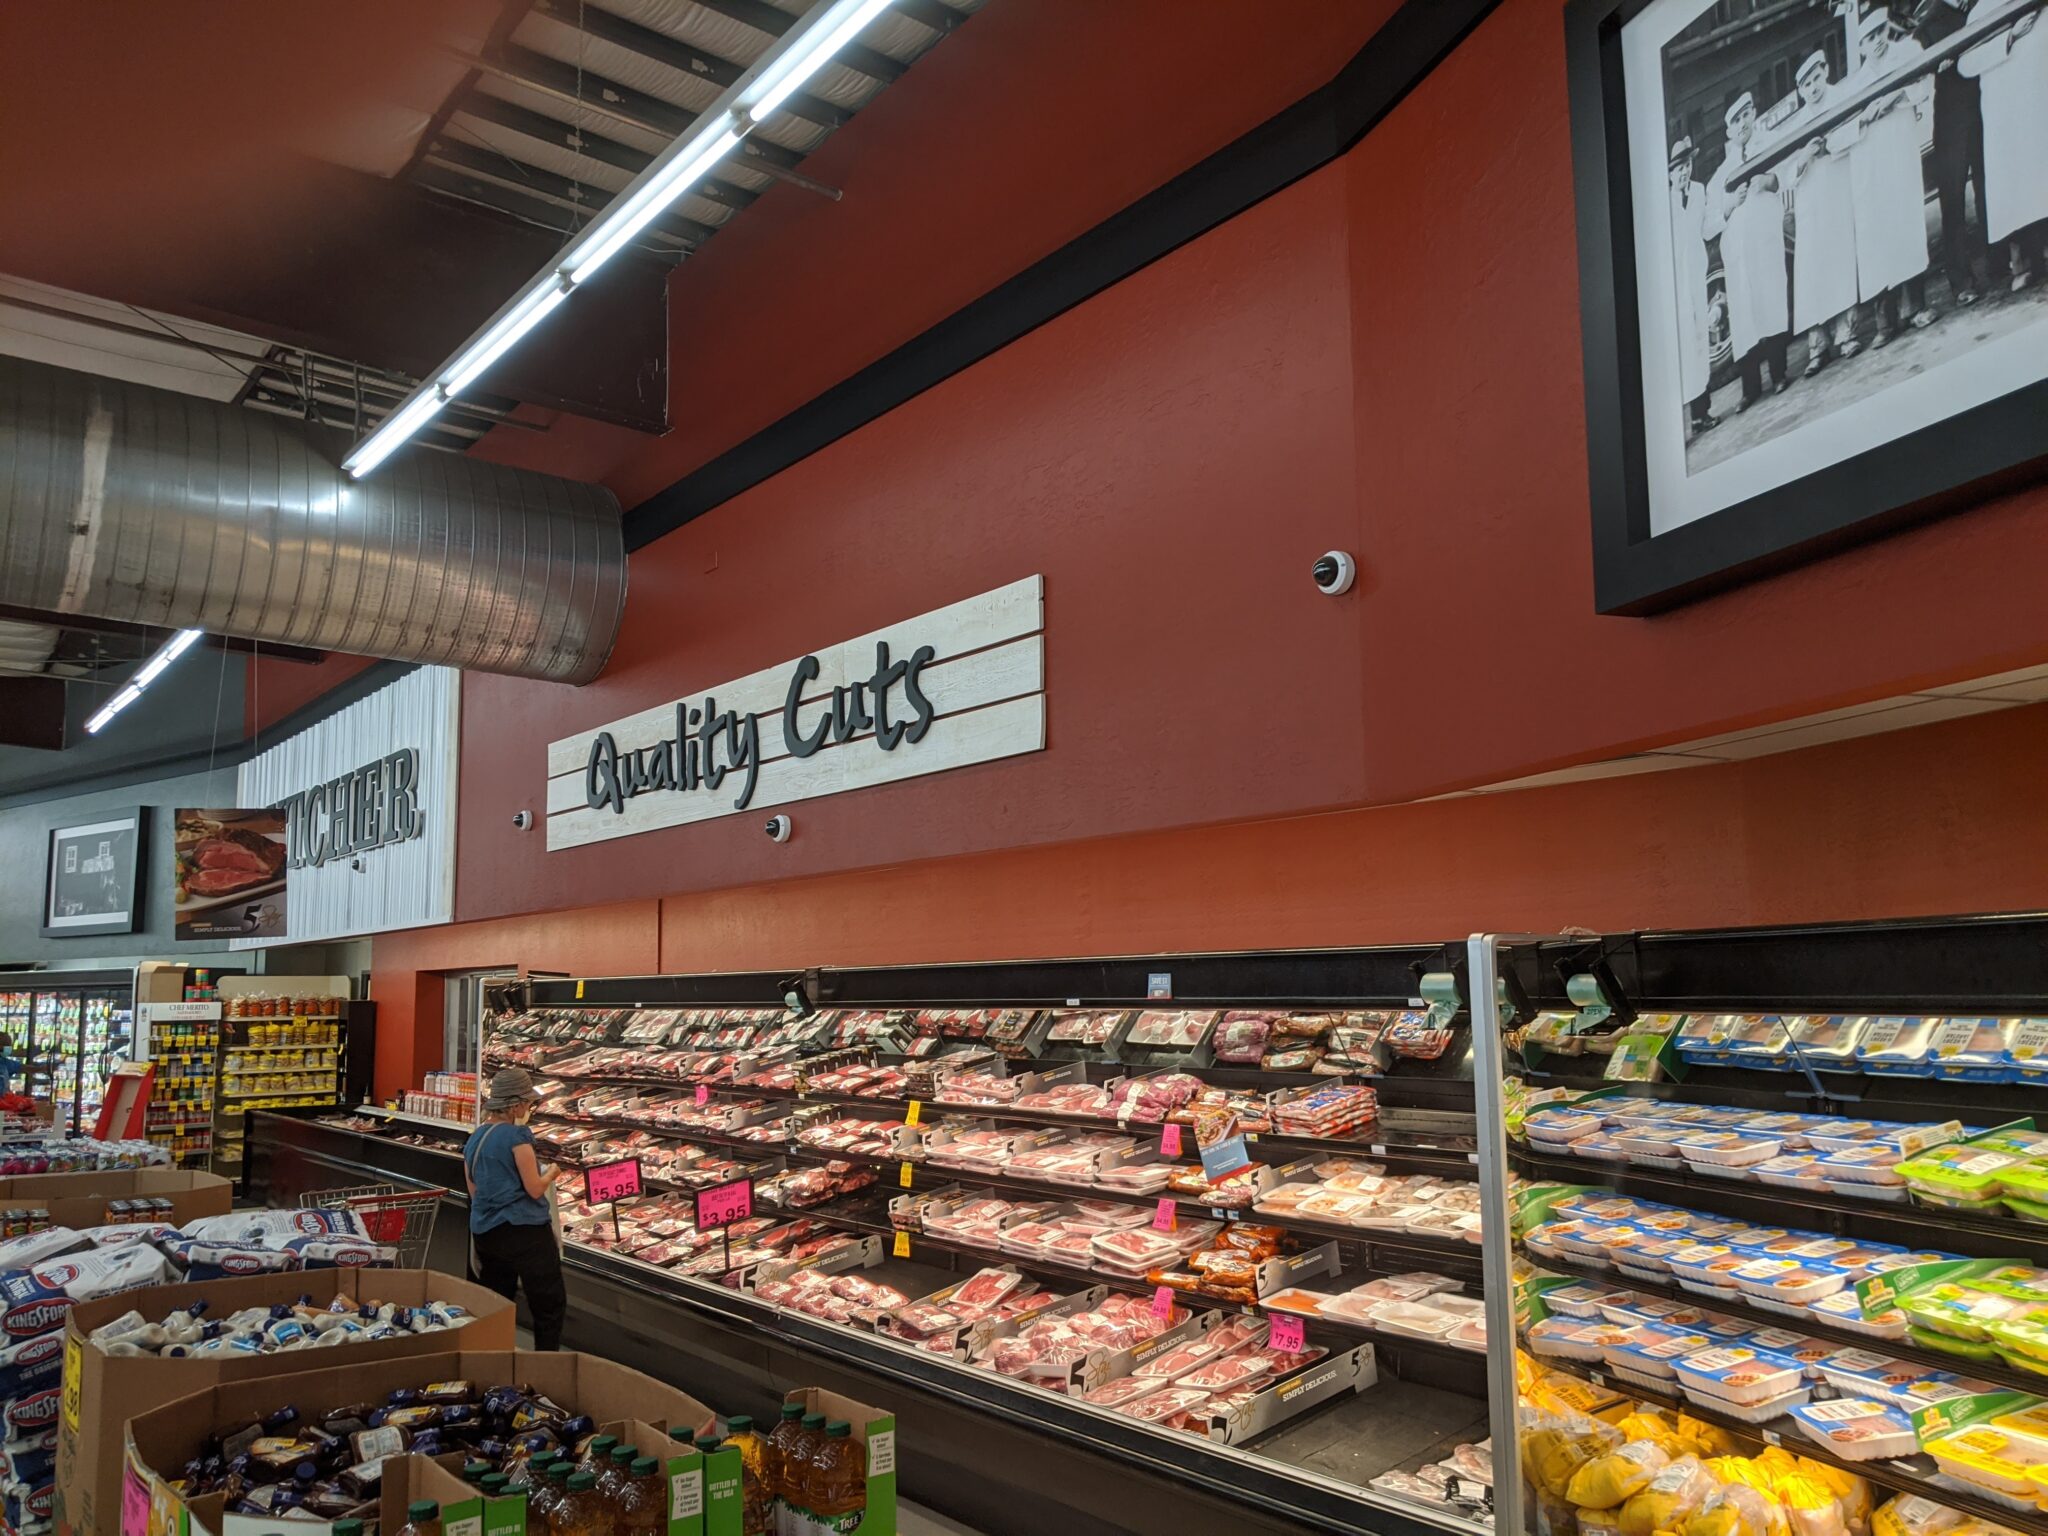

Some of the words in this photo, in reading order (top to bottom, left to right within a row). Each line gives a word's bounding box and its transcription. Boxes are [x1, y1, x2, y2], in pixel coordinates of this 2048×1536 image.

[586, 697, 760, 814] Quality
[783, 641, 935, 758] Cuts
[269, 748, 419, 867] TCHER
[594, 1181, 635, 1200] $5.95
[703, 1204, 747, 1226] $3.95
[224, 1258, 259, 1271] KINGSFORD
[337, 1251, 370, 1263] KINGSFORD
[7, 1305, 67, 1328] KINGSFOR
[1282, 1384, 1306, 1402] SIMPLY
[709, 1480, 731, 1491] BOTTLED
[839, 1513, 860, 1530] TREE
